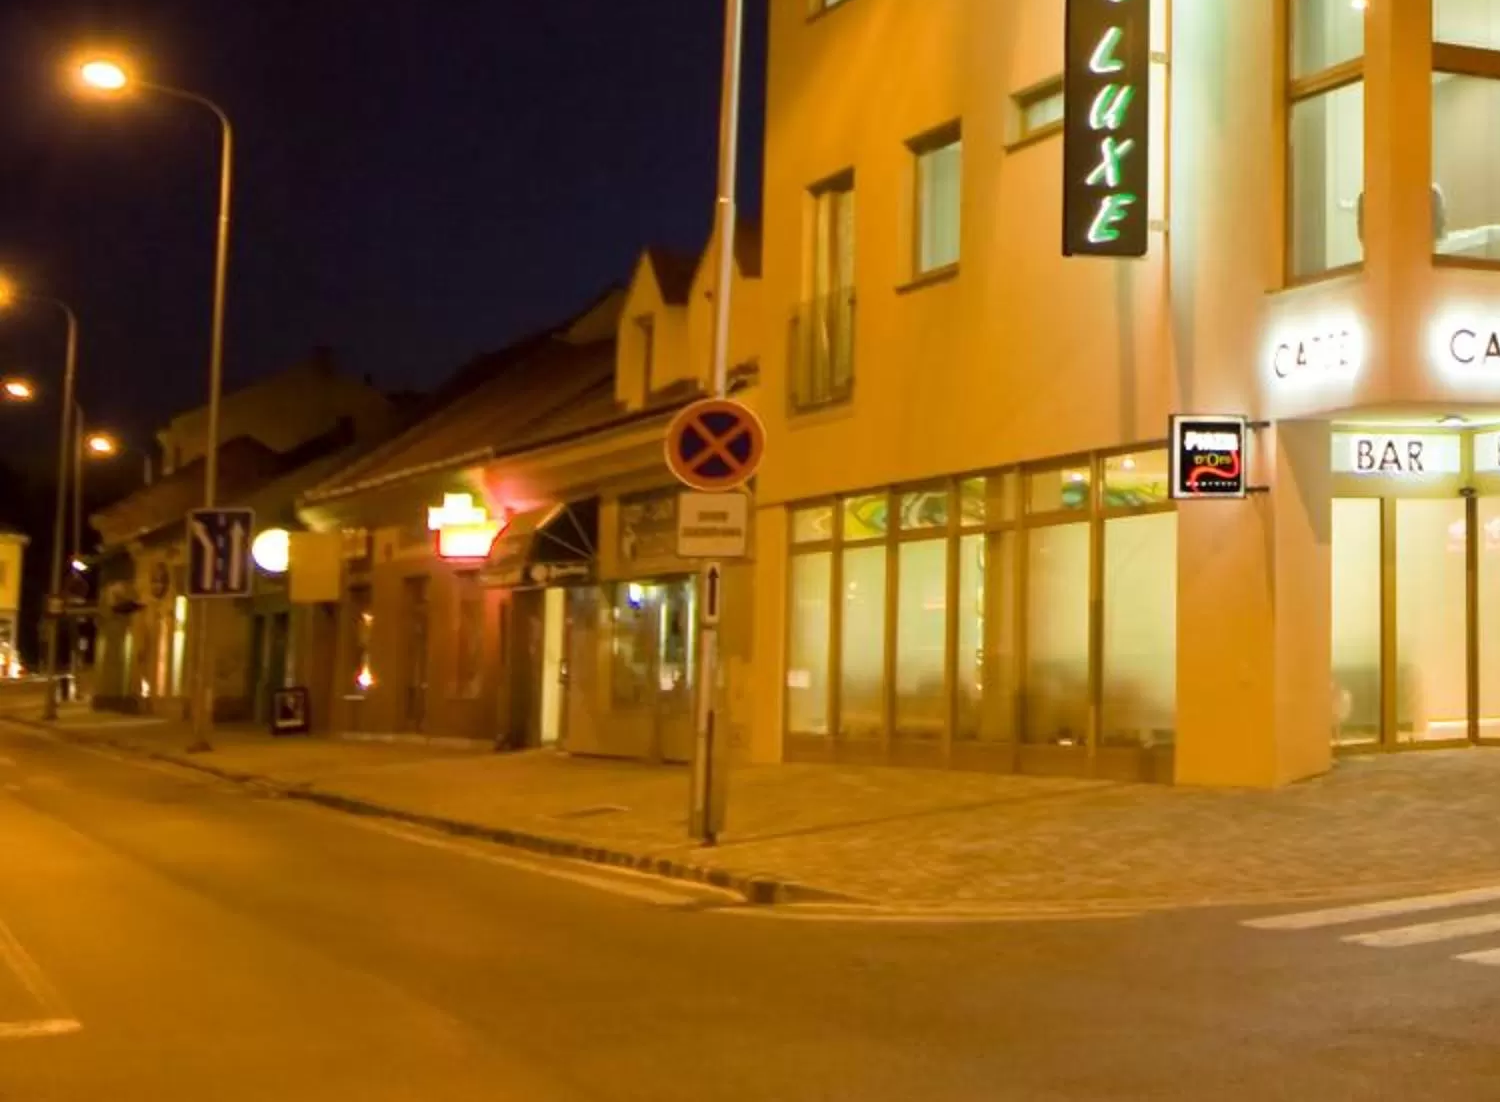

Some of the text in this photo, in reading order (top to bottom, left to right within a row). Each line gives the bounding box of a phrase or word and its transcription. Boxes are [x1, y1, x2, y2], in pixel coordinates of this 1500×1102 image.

[1085, 26, 1136, 244] LUXE
[1273, 330, 1349, 378] CAE
[1356, 439, 1425, 471] BAR
